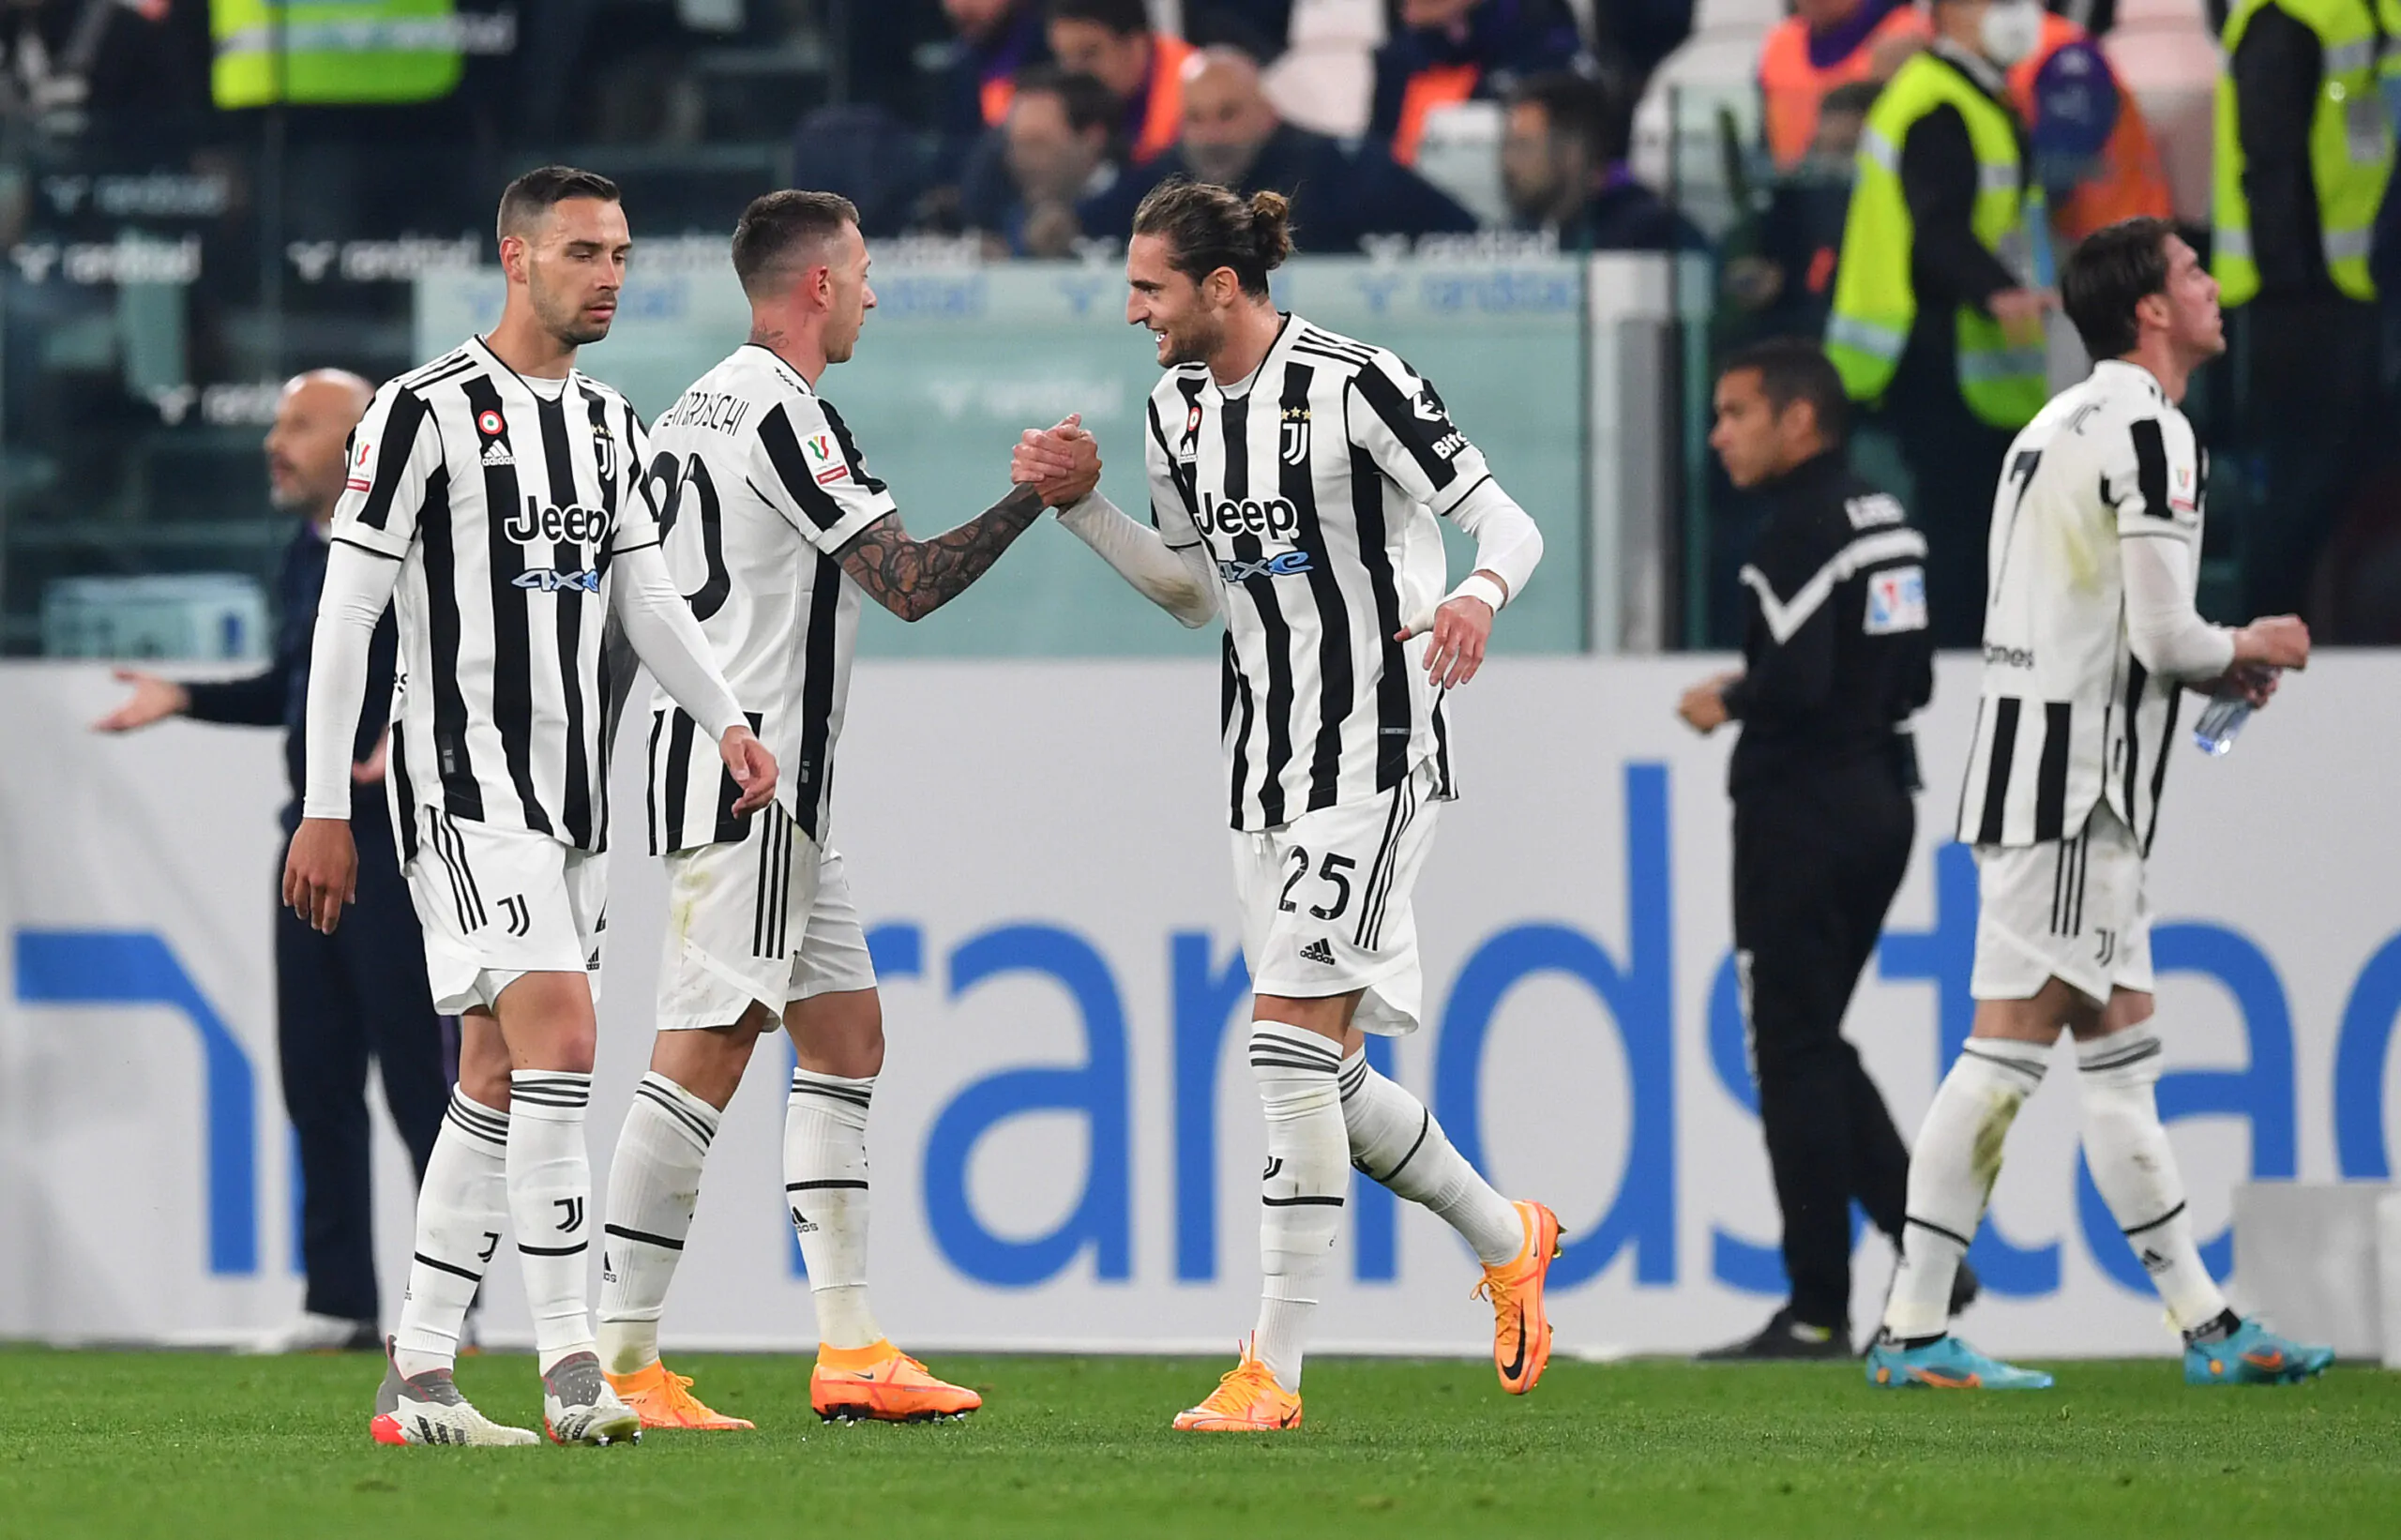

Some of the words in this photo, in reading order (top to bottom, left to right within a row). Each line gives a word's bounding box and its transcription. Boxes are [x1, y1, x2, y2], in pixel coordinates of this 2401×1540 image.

[506, 494, 609, 552] Jeep
[1195, 491, 1298, 541] Jeep
[1991, 448, 2043, 608] 7
[1277, 844, 1356, 921] 25
[1299, 949, 1336, 966] adidas
[784, 760, 2401, 1299] andta
